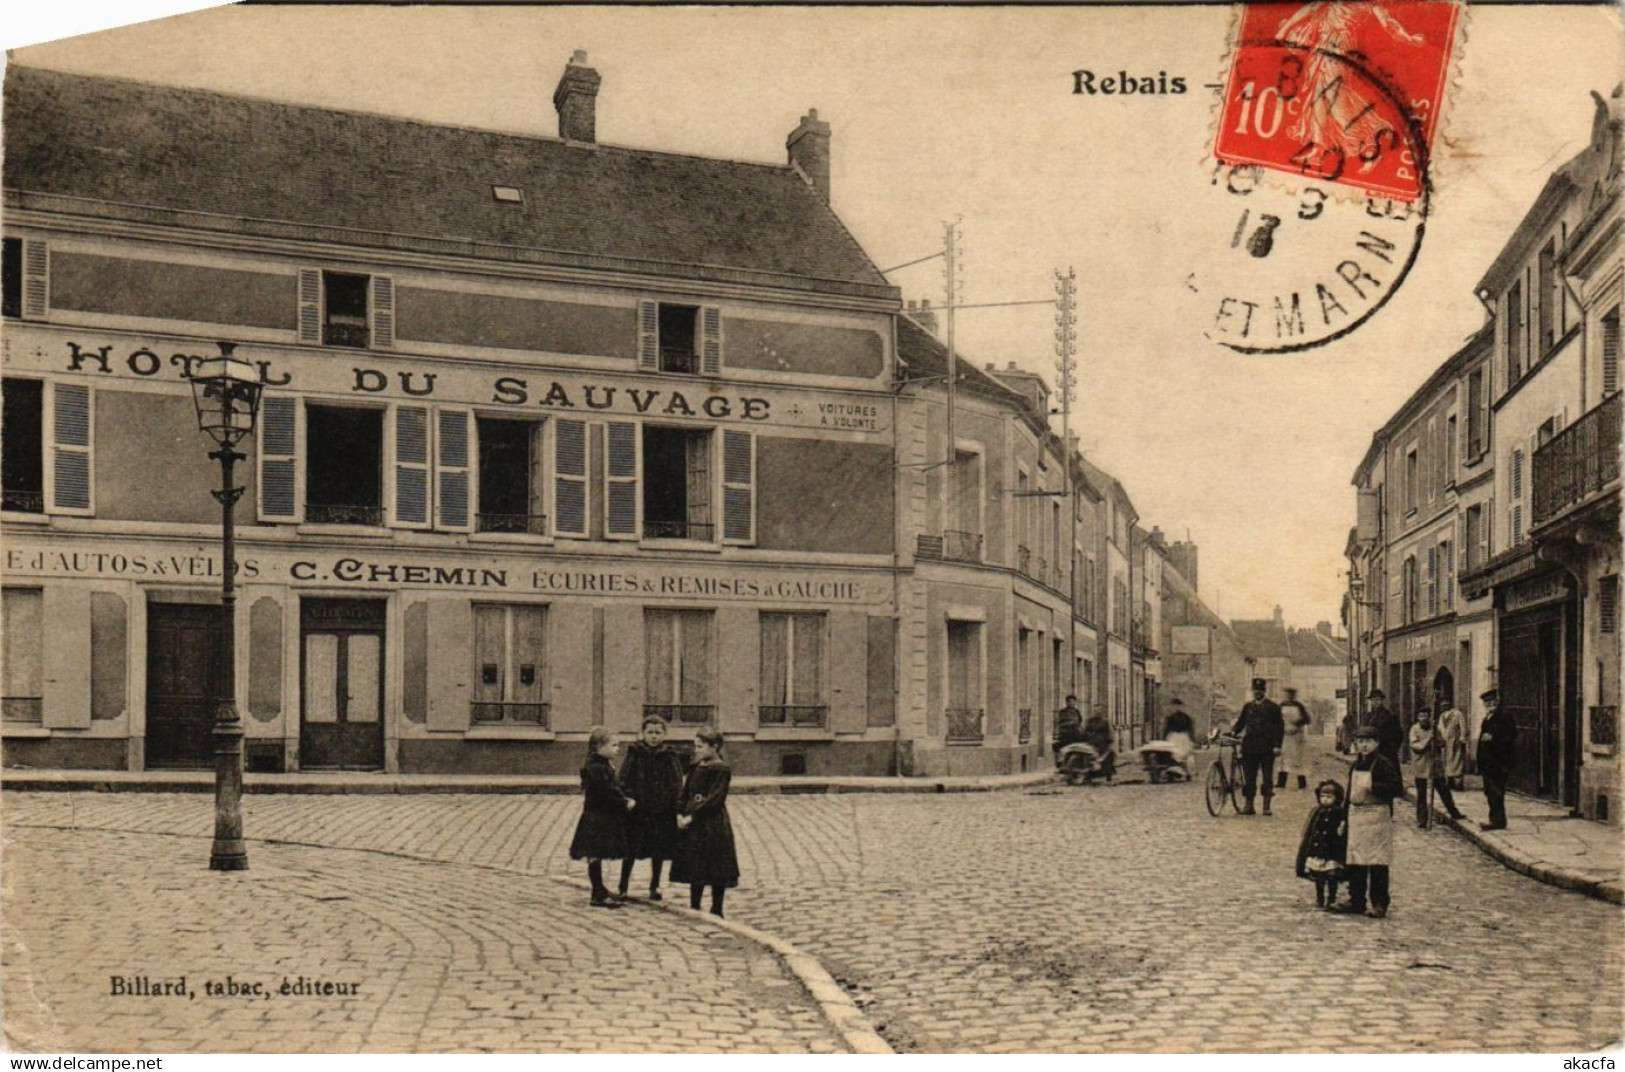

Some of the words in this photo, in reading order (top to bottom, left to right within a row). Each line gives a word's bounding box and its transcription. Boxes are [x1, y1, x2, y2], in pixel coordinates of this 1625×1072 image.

[66, 341, 292, 386] HÔTL
[352, 367, 438, 396] DU
[492, 376, 771, 421] SAUVAGE
[818, 403, 877, 417] VOITURES
[332, 558, 507, 587] CHEMIN
[660, 576, 760, 597] REMISES
[777, 580, 861, 599] GAUCHE
